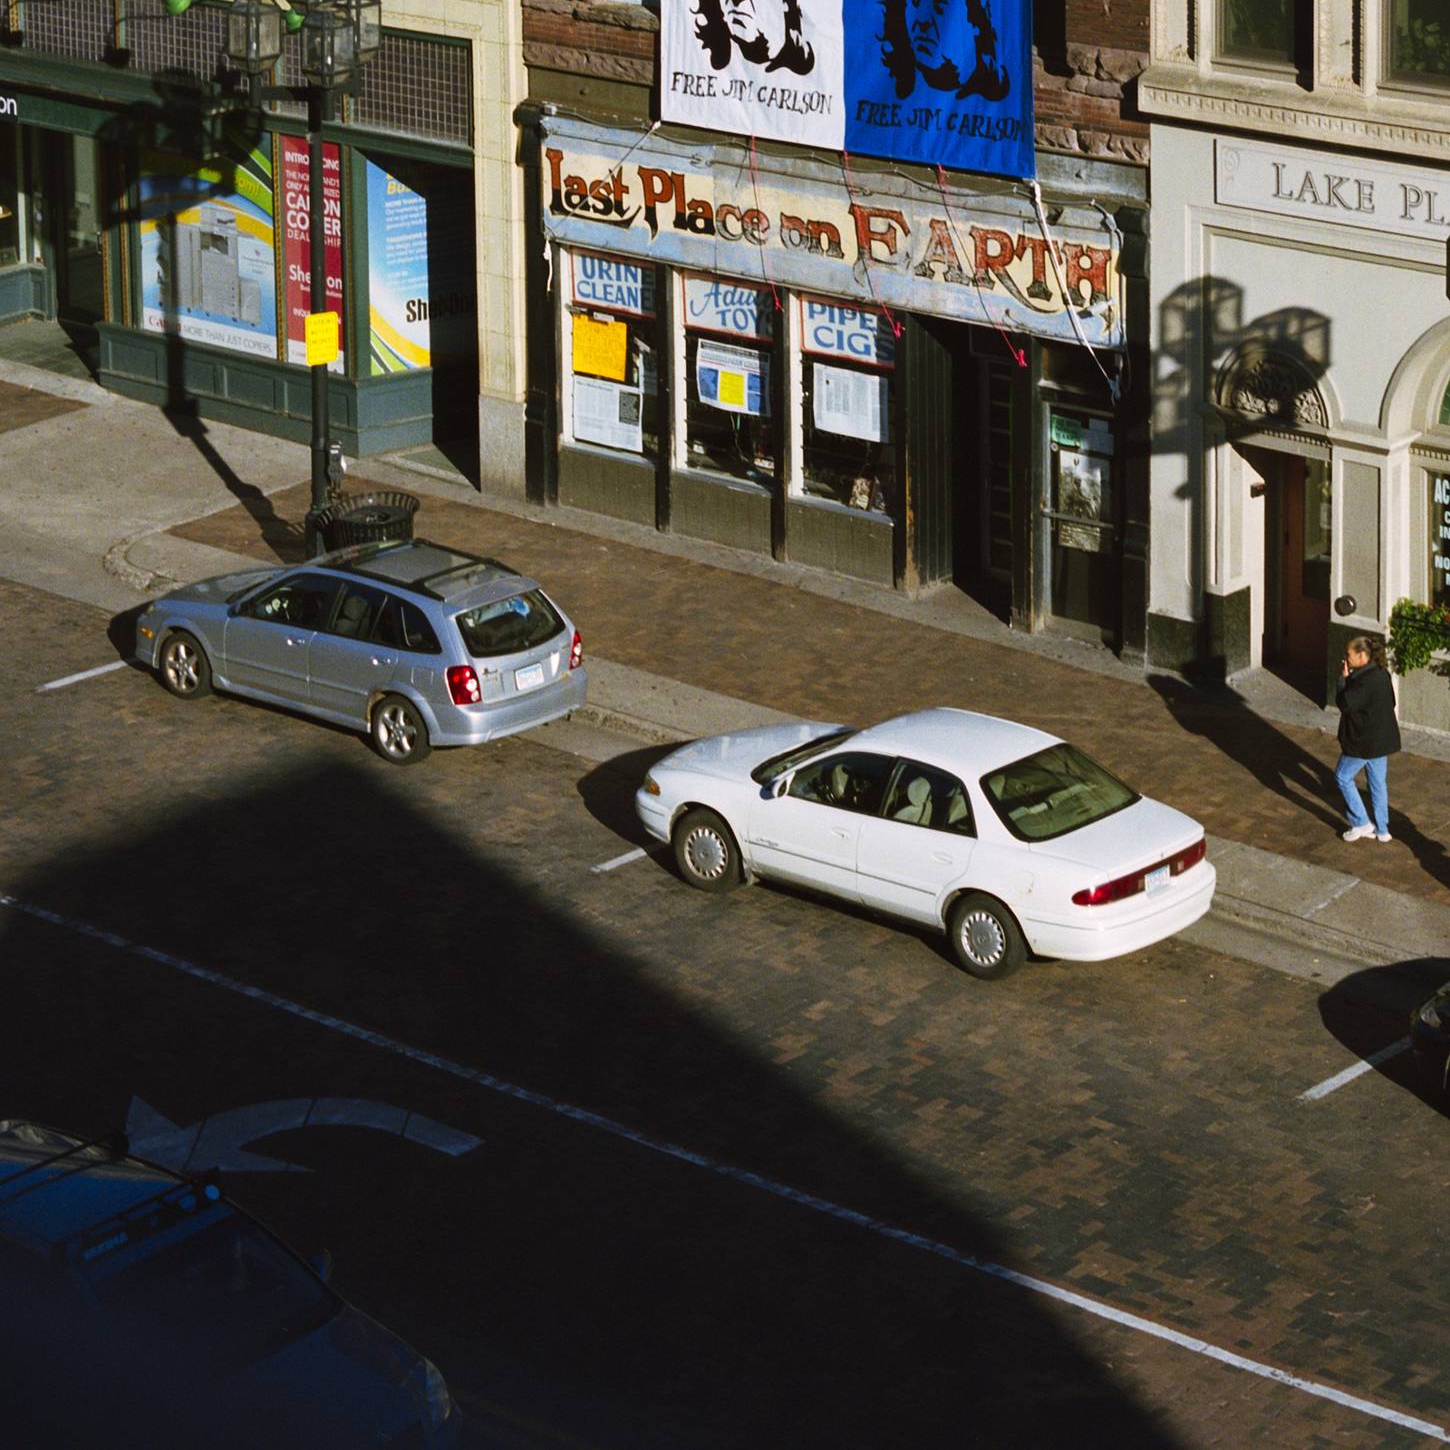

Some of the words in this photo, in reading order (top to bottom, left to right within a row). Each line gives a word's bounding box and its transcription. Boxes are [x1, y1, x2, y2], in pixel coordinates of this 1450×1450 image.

[671, 71, 718, 98] FREE
[722, 79, 753, 102] JIM
[757, 86, 832, 115] CARLSON
[855, 100, 901, 127] FREE
[906, 107, 942, 132] JIM
[946, 112, 1027, 143] CARLSON
[285, 151, 340, 171] INTROING
[1272, 161, 1376, 214] LAKE
[286, 191, 341, 218] CAN
[287, 210, 342, 237] COER
[287, 229, 341, 247] DEALHIP
[637, 165, 770, 240] Place
[780, 191, 845, 259] on
[848, 203, 1112, 314] EARTH
[289, 264, 343, 290] Sheon
[581, 254, 655, 287] URINE
